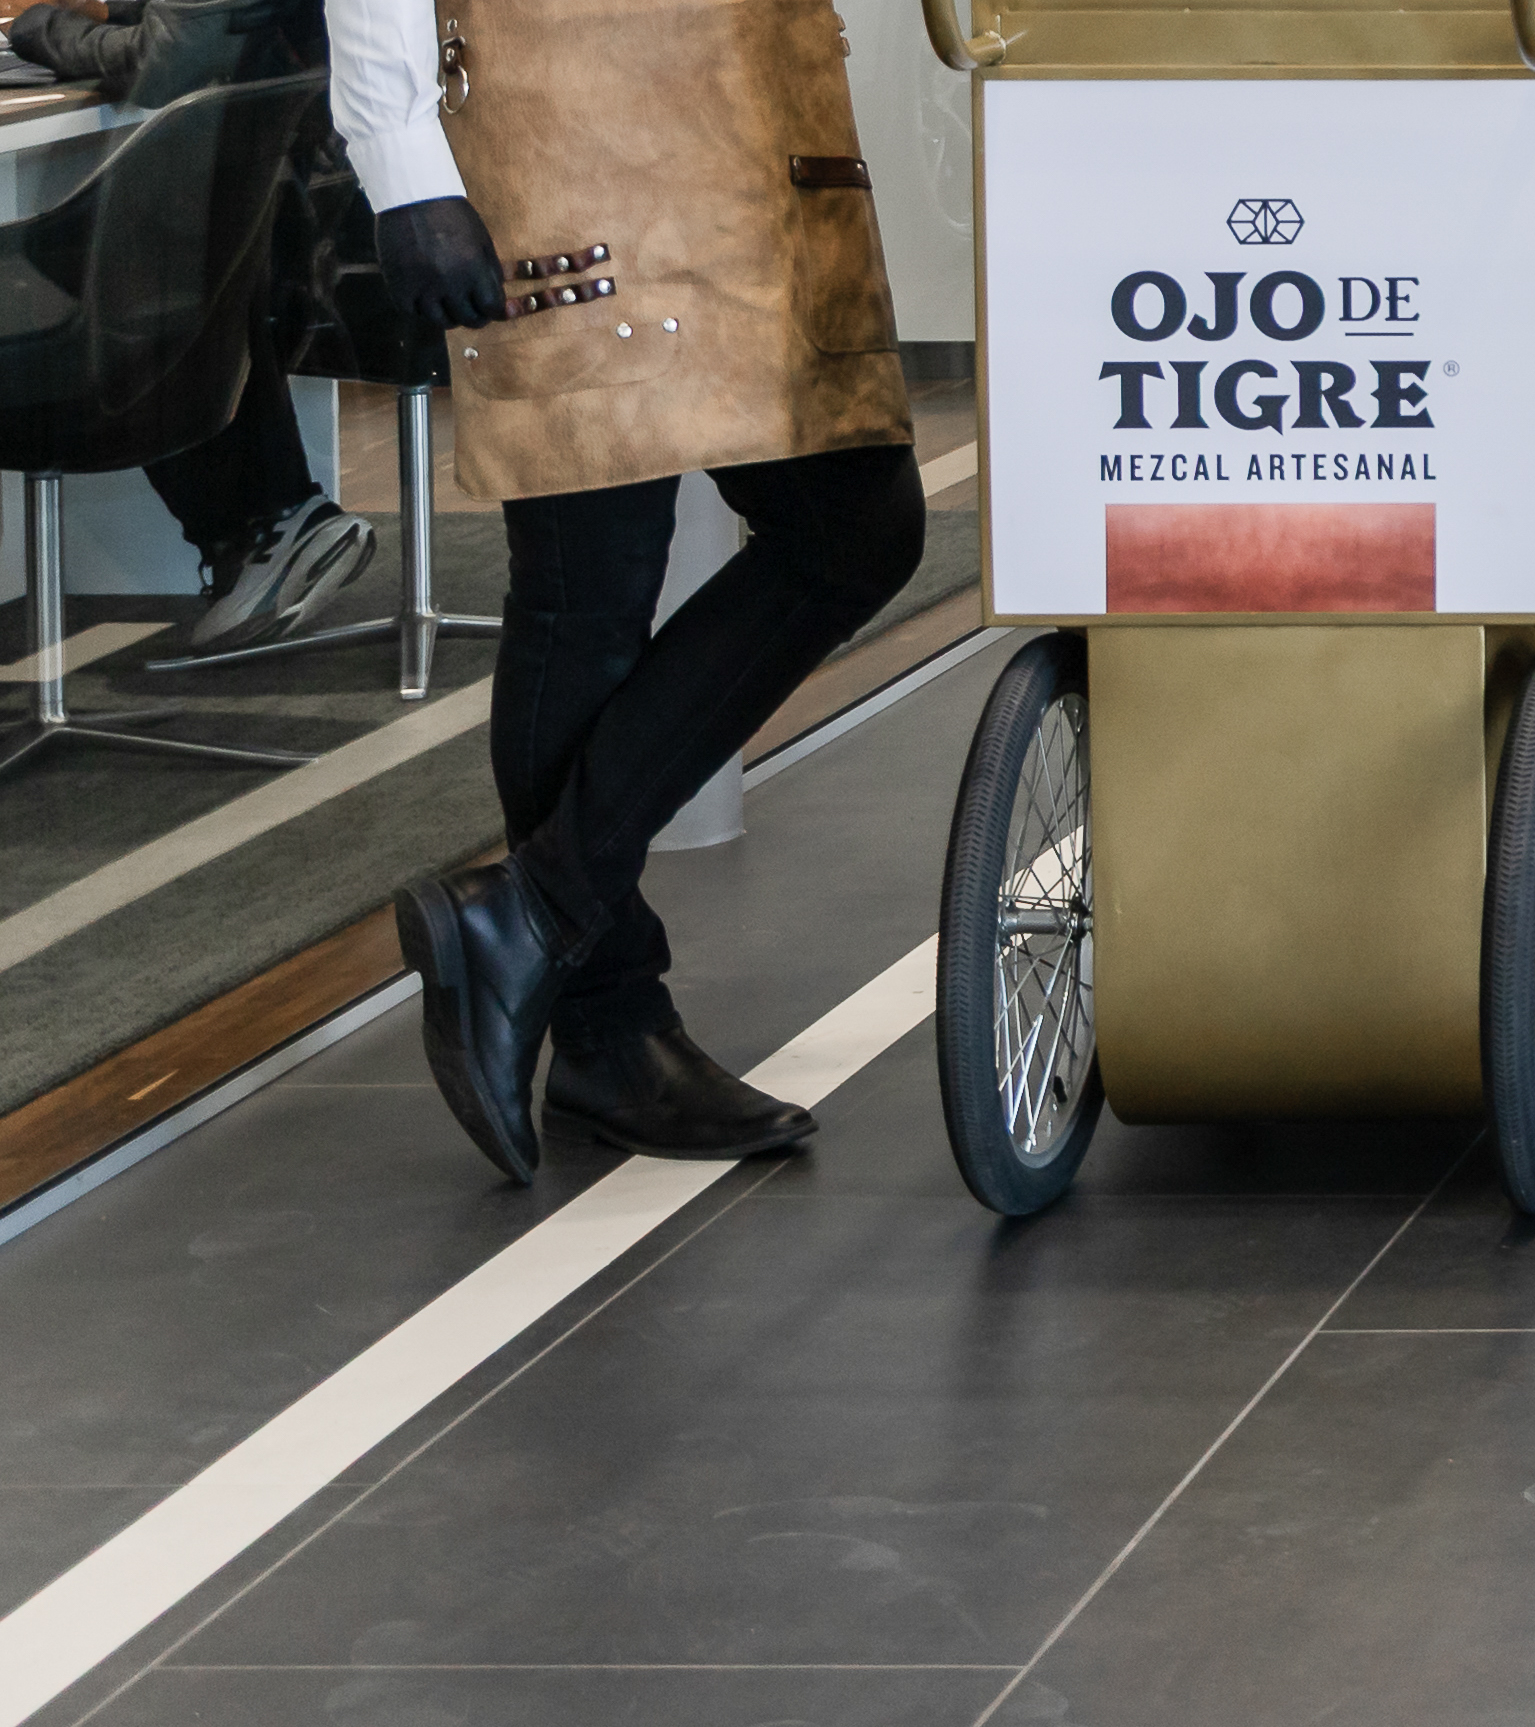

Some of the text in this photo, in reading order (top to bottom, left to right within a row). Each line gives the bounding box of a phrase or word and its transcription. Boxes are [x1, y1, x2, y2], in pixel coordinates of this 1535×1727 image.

[1110, 270, 1420, 342] OJO DE
[1098, 359, 1436, 436] TIGRE
[1099, 454, 1437, 483] MEZCAL ARTESANAL
